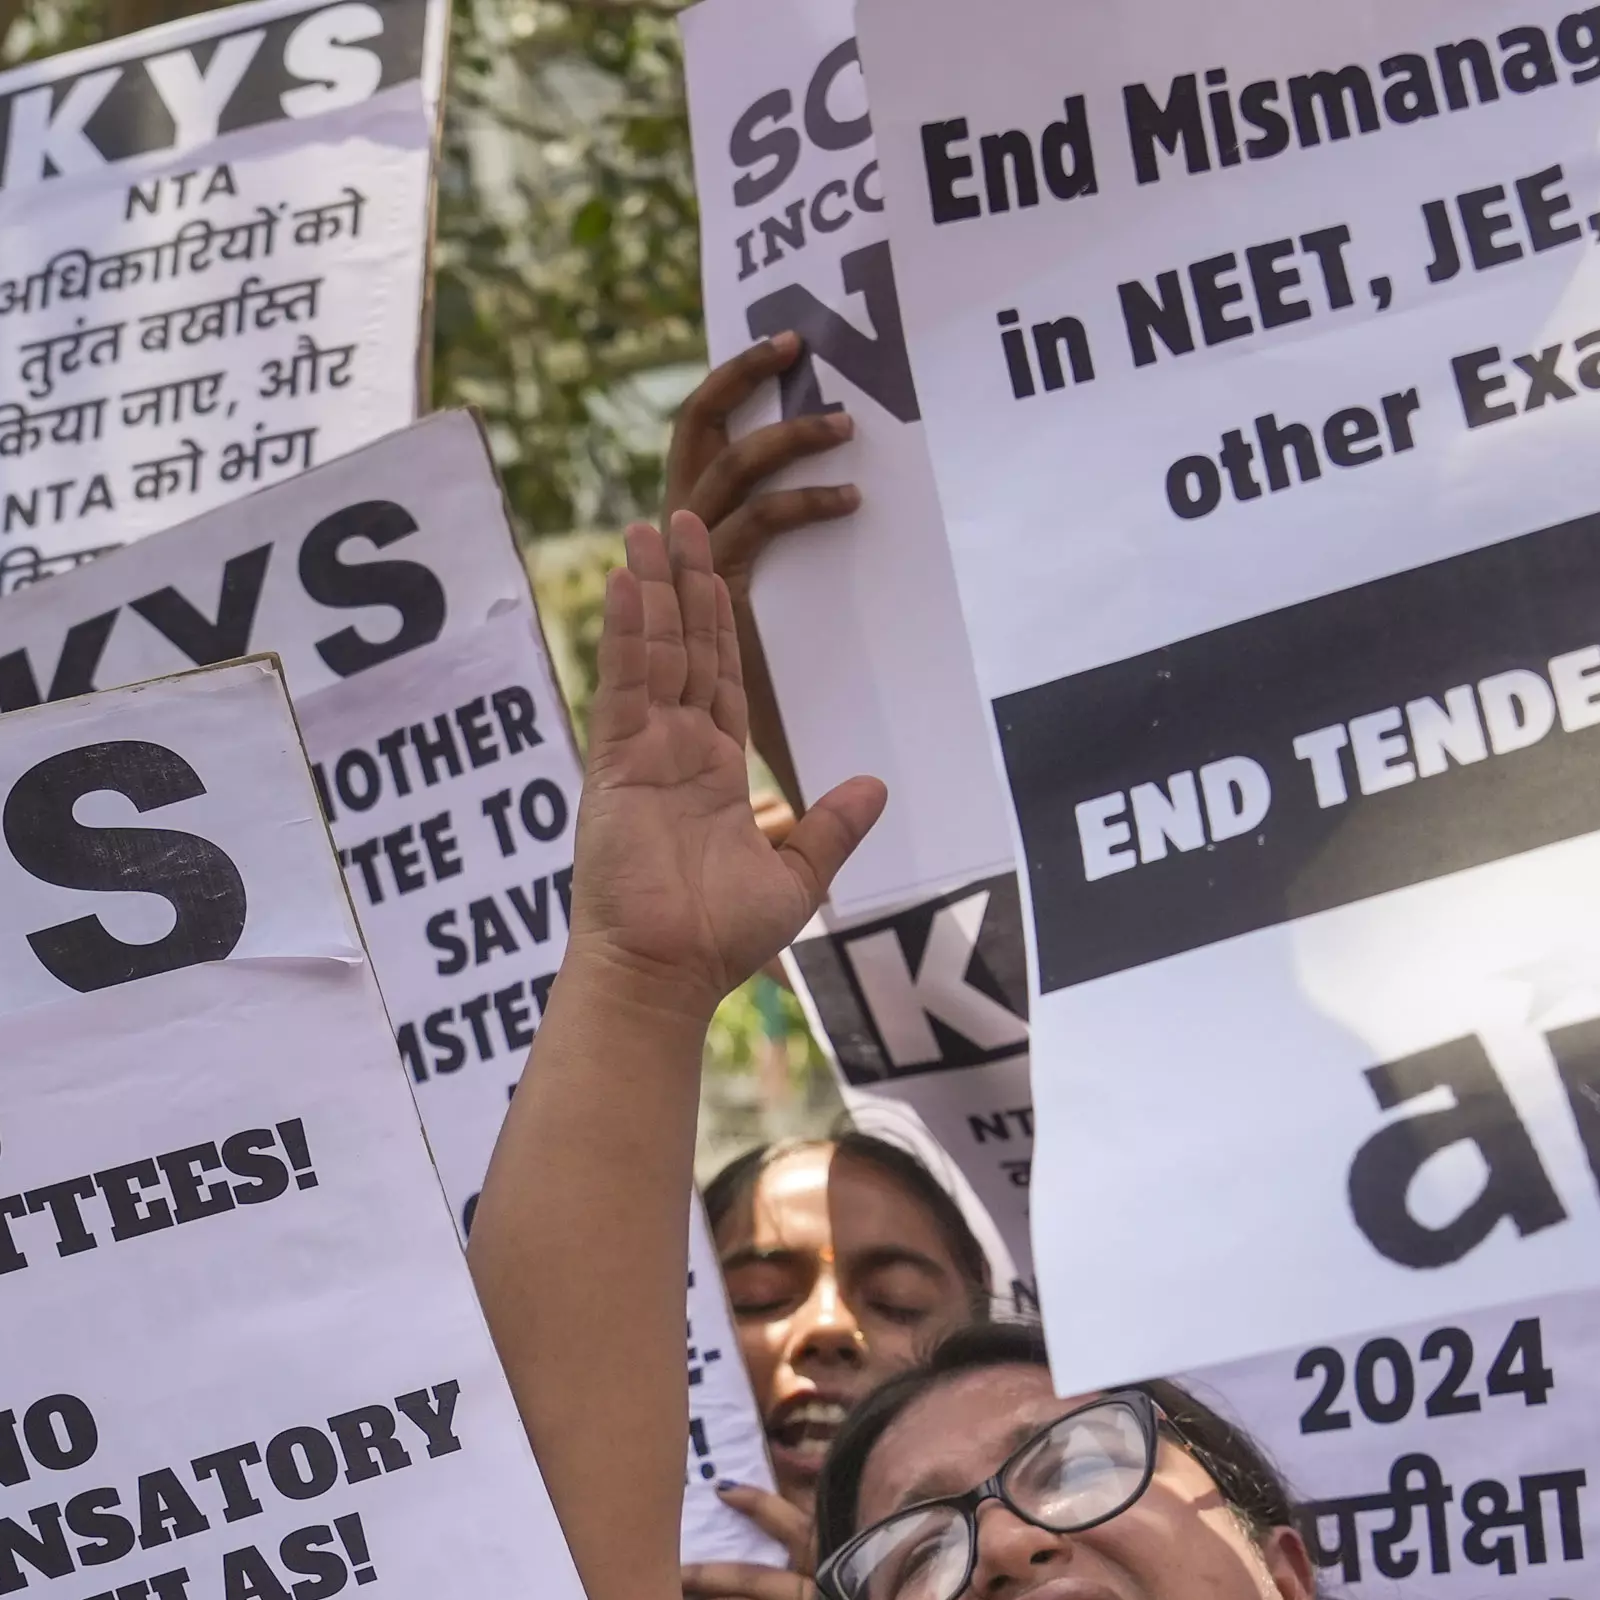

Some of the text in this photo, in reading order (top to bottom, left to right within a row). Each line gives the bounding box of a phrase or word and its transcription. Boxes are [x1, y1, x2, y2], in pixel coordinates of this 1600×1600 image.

[2, 2, 385, 186] KYS
[124, 163, 240, 221] NTA
[293, 187, 369, 245] को
[919, 92, 1097, 227] End
[18, 275, 326, 398] तुरंत बर्खास्त
[998, 307, 1097, 401] in
[1117, 222, 1395, 369] NEET,
[121, 371, 238, 429] जाए,
[259, 333, 357, 399] और
[3, 422, 319, 533] NTA को भंग
[1165, 386, 1423, 521] other
[336, 776, 569, 905] TEE TO
[1074, 755, 1272, 883] END
[844, 890, 1030, 1068] K
[1295, 1316, 1555, 1435] 2024
[1295, 1452, 1587, 1583] परीक्षा
